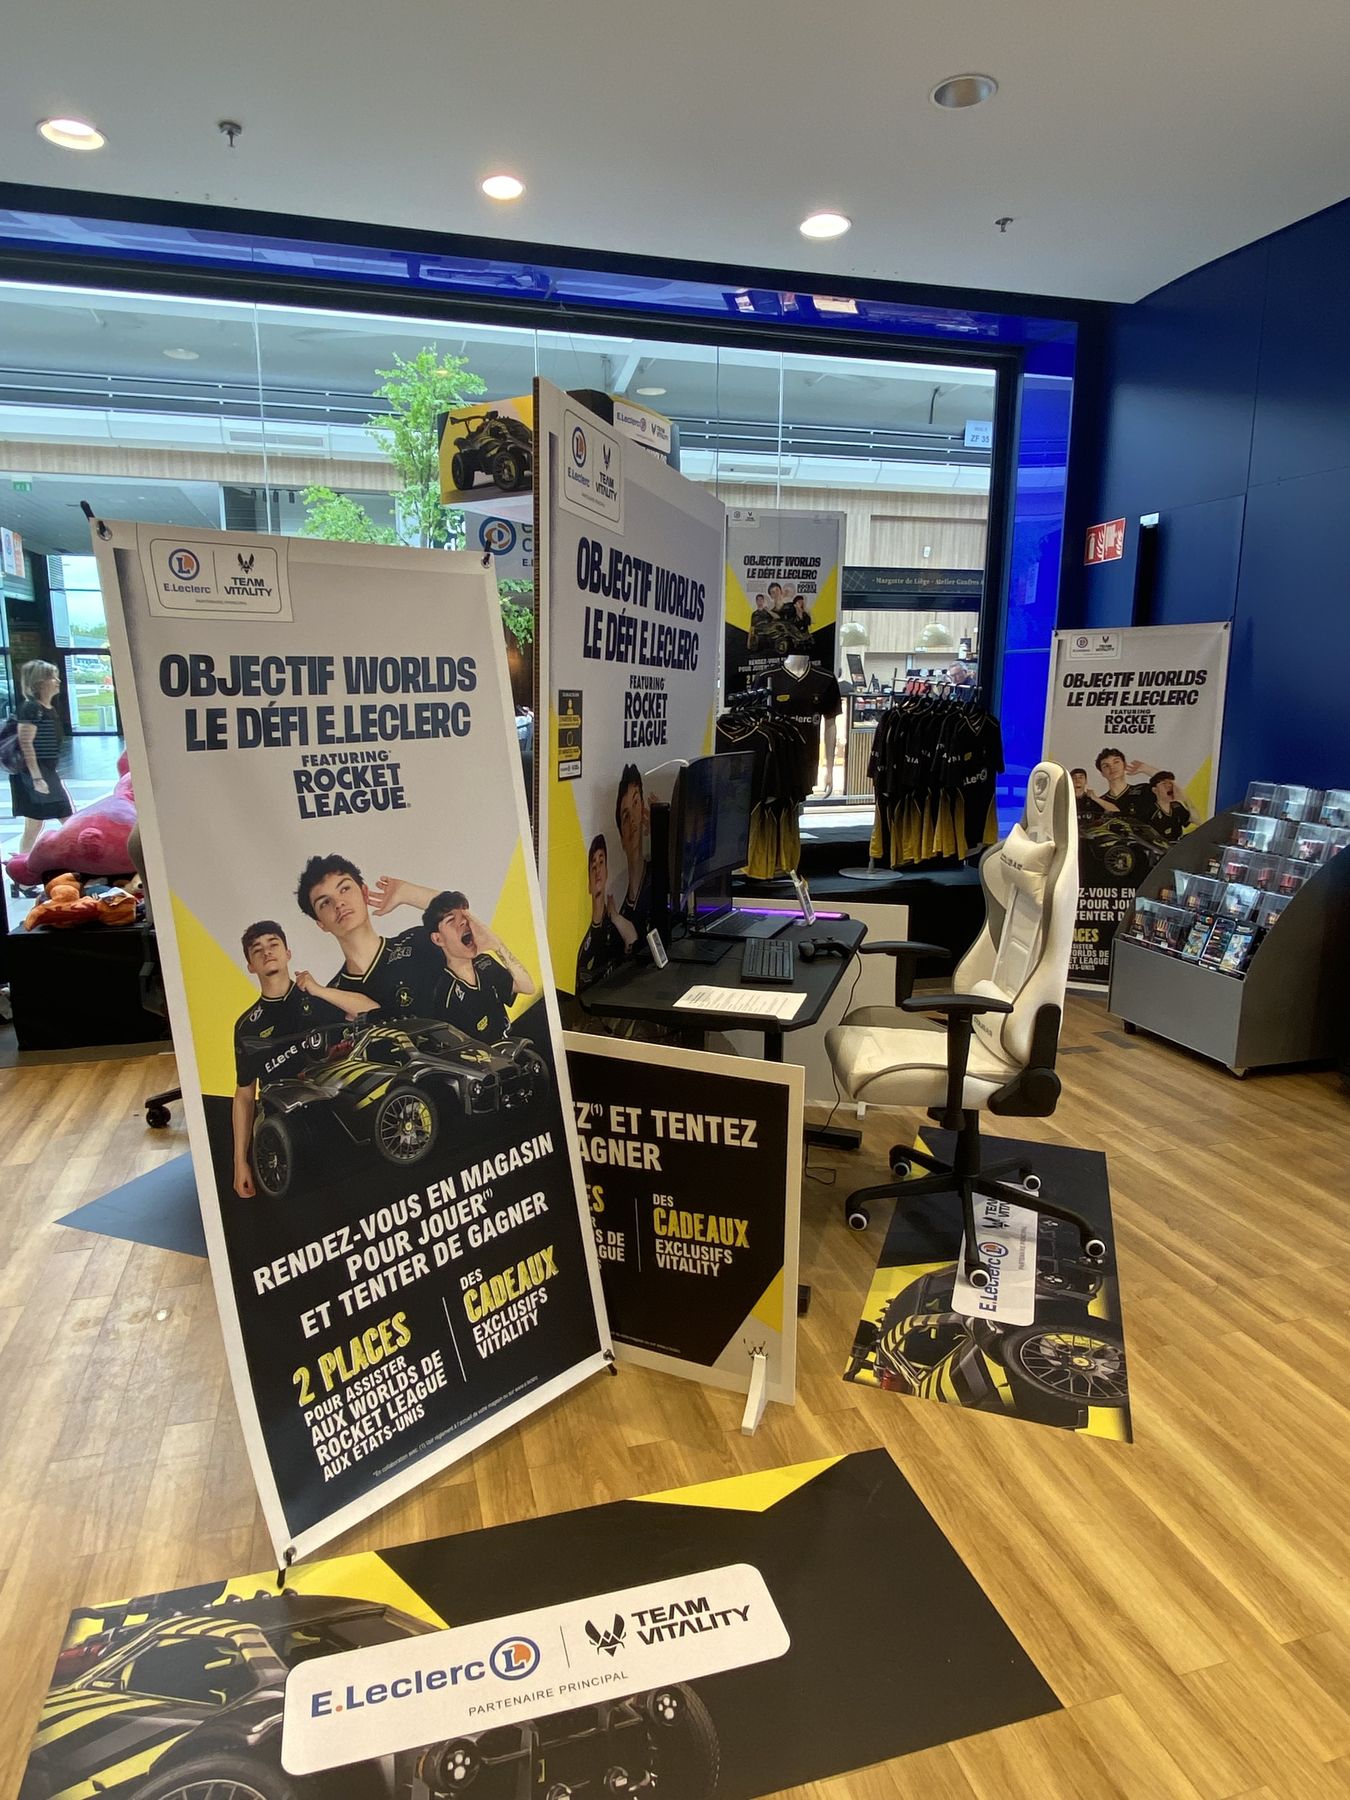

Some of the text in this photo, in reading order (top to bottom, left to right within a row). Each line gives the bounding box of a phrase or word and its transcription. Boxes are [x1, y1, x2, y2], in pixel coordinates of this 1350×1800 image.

[596, 482, 617, 501] VITALITY
[600, 472, 614, 489] TEAM
[744, 556, 822, 567] OBJECTIF WORLDS
[746, 567, 818, 580] LE DÉFI E.LECLERC
[164, 583, 212, 594] E.Leclerc
[224, 586, 272, 597] VITALITY
[231, 576, 264, 587] TEAM
[577, 536, 653, 608] OBJECTIF
[655, 566, 706, 622] WORLDS
[583, 606, 698, 672] LE DÉFI E.LECLERC
[159, 654, 477, 698] OBJECTIF WORLDS
[630, 675, 665, 690] FEATURING
[1063, 670, 1208, 688] OBJECTIF WORLDS
[624, 691, 668, 720] ROCKET
[1067, 690, 1199, 706] LE DÉFI E.LECLERC
[185, 701, 471, 752] LE DÉFI E.LECLERC
[1104, 724, 1156, 734] LEAGUE
[1105, 714, 1156, 724] ROCKET
[624, 720, 667, 748] LEAGUE
[301, 750, 390, 768] FEATURING
[293, 763, 400, 794] ROCKET
[298, 786, 407, 820] LEAGUE
[1079, 888, 1136, 898] Z-VOUS EN
[1080, 900, 1109, 910] POUR
[1073, 928, 1100, 942] ACES
[1080, 957, 1109, 966] LEAGUE
[610, 1105, 642, 1134] ET
[651, 1109, 758, 1148] TENTEZ
[578, 1134, 662, 1172] AGNER
[253, 1132, 554, 1296] RENDEZ-VOUS EN MAGASIN
[652, 1193, 674, 1208] DES
[985, 1199, 998, 1216] TEA
[608, 1231, 625, 1248] DE
[653, 1207, 750, 1248] CADEAUX
[300, 1301, 332, 1339] ET
[338, 1252, 430, 1316] TENTER
[432, 1234, 464, 1268] DE
[468, 1191, 549, 1248] GAGNER
[346, 1230, 413, 1282] POUR
[598, 1245, 626, 1262] GUE
[656, 1238, 733, 1264] EXCLUSIFS
[460, 1268, 483, 1290] DES
[656, 1253, 720, 1278] VITALITY
[463, 1244, 559, 1324] CADEAUX
[472, 1287, 548, 1344] EXCLUSIFS
[476, 1308, 538, 1359] VITALITY
[293, 1312, 412, 1408] 2 PLACES
[304, 1356, 408, 1428] POUR ASSISTER
[312, 1350, 444, 1447] AUX WORLDS DE
[316, 1408, 386, 1466] ROCKET
[386, 1368, 448, 1420] LEAGUE
[322, 1454, 352, 1482] AUX
[352, 1404, 426, 1462] ÉTATS-UNIS
[631, 1596, 710, 1627] TEAM
[636, 1604, 750, 1646] VITALITY
[311, 1661, 486, 1718] E.Leclerc
[468, 1671, 628, 1716] PARTENAIRE PRINCIPAL
